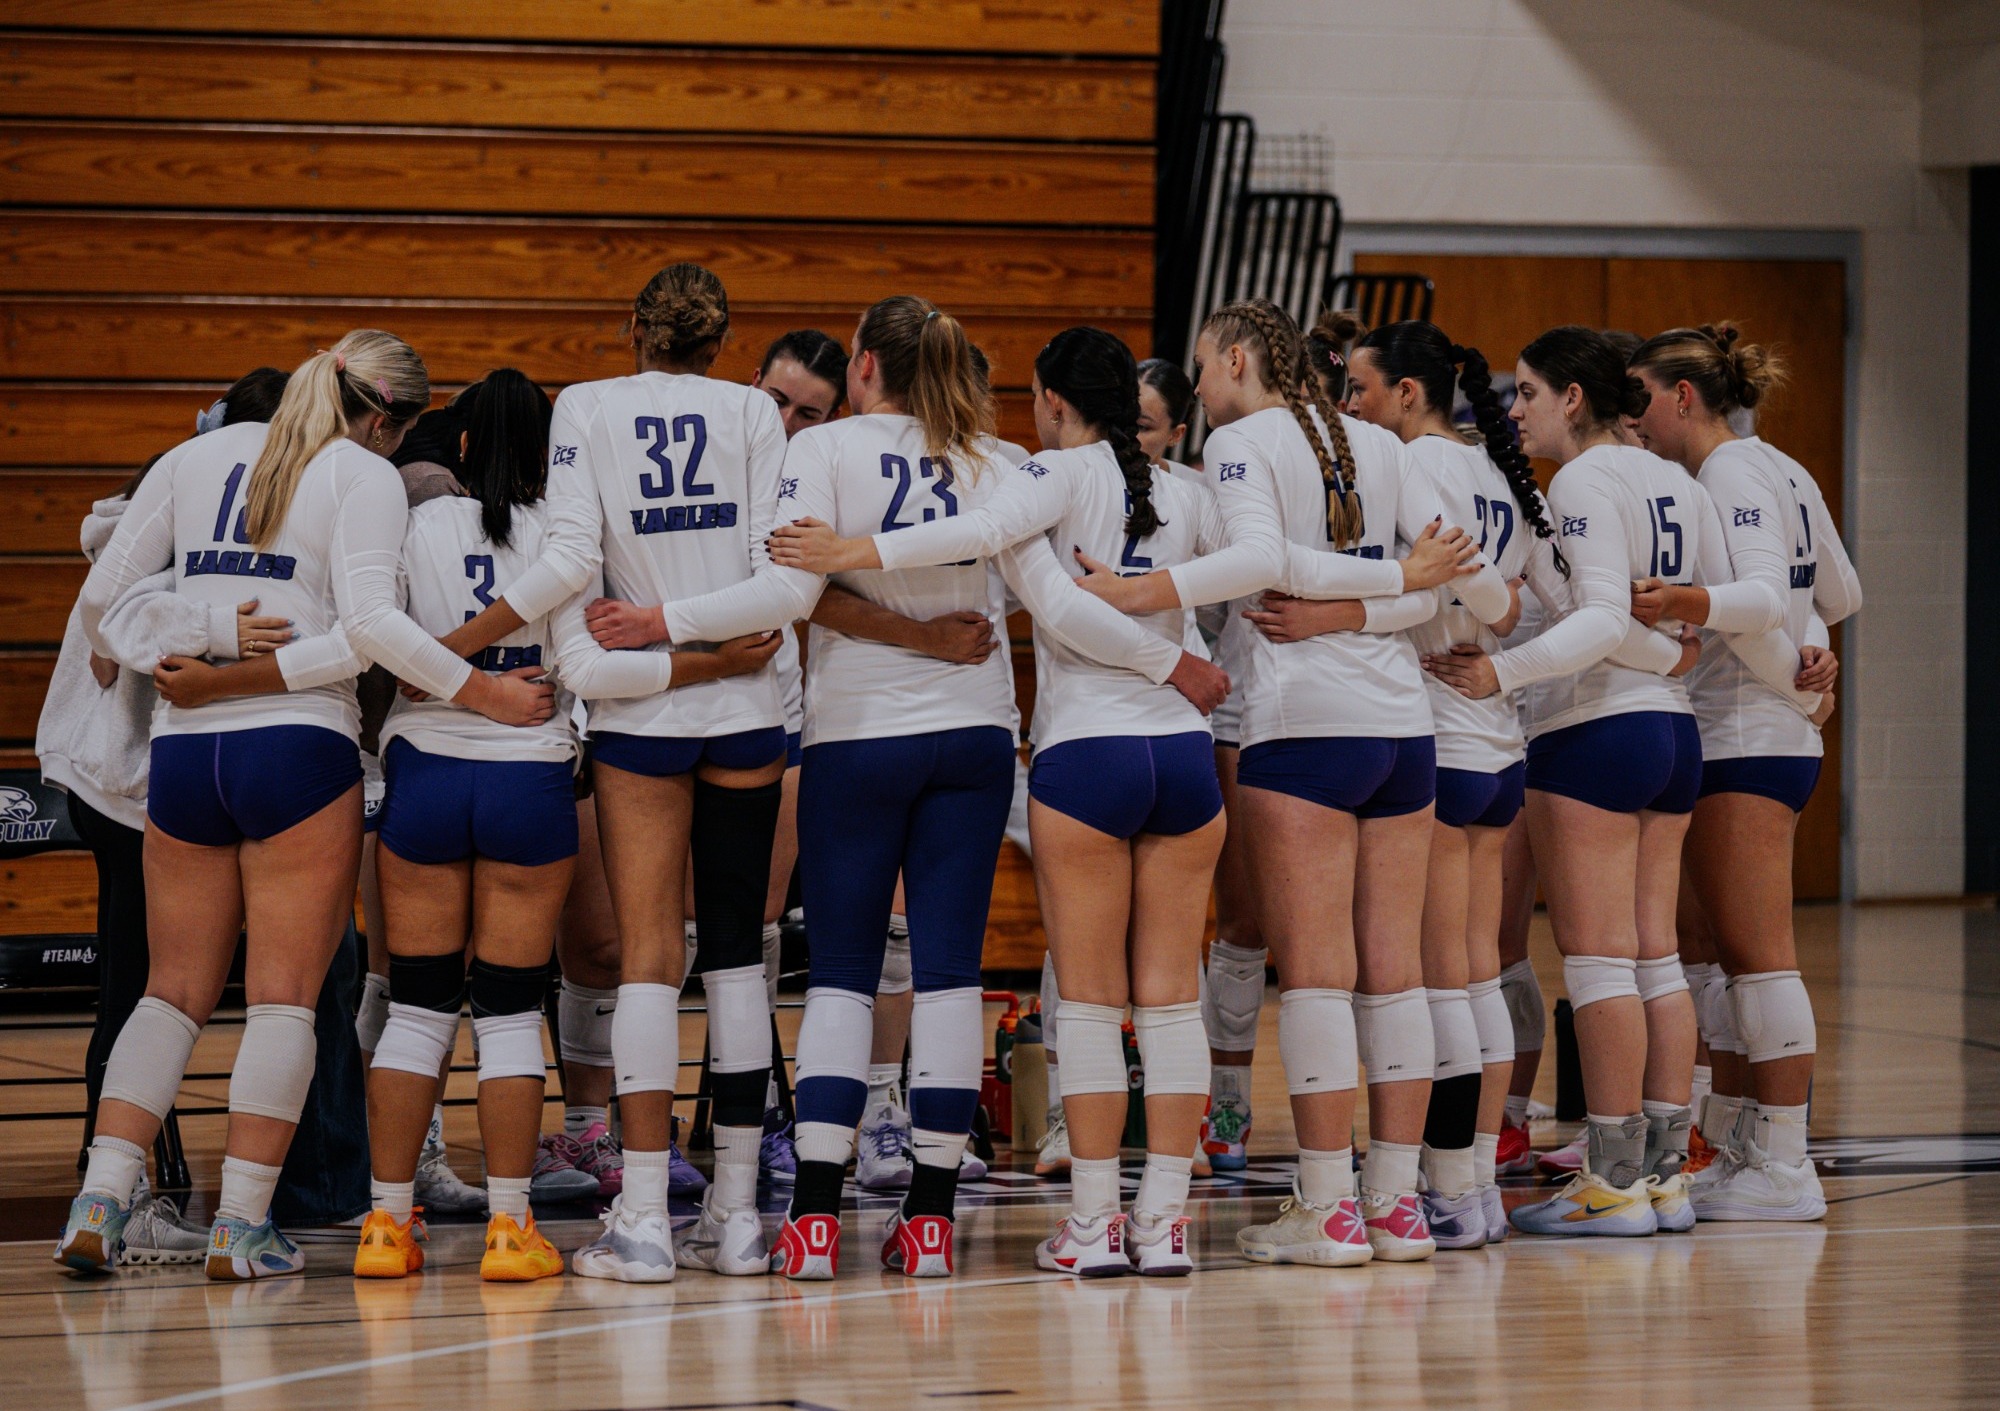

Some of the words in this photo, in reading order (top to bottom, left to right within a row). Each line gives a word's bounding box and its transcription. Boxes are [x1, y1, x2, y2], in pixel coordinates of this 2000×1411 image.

[553, 446, 578, 467] CCS
[635, 414, 714, 499] 32
[1220, 462, 1247, 482] CCS
[213, 463, 258, 544] 1
[881, 453, 958, 533] 23
[630, 502, 738, 535] EAGLES
[1562, 516, 1588, 537] CCS
[1733, 508, 1760, 527] CCS
[1646, 496, 1683, 577] 15
[184, 550, 297, 580] EAGLES
[464, 554, 497, 624] 3
[0, 818, 58, 843] URY
[811, 1220, 828, 1248] 0
[923, 1221, 940, 1248] 0
